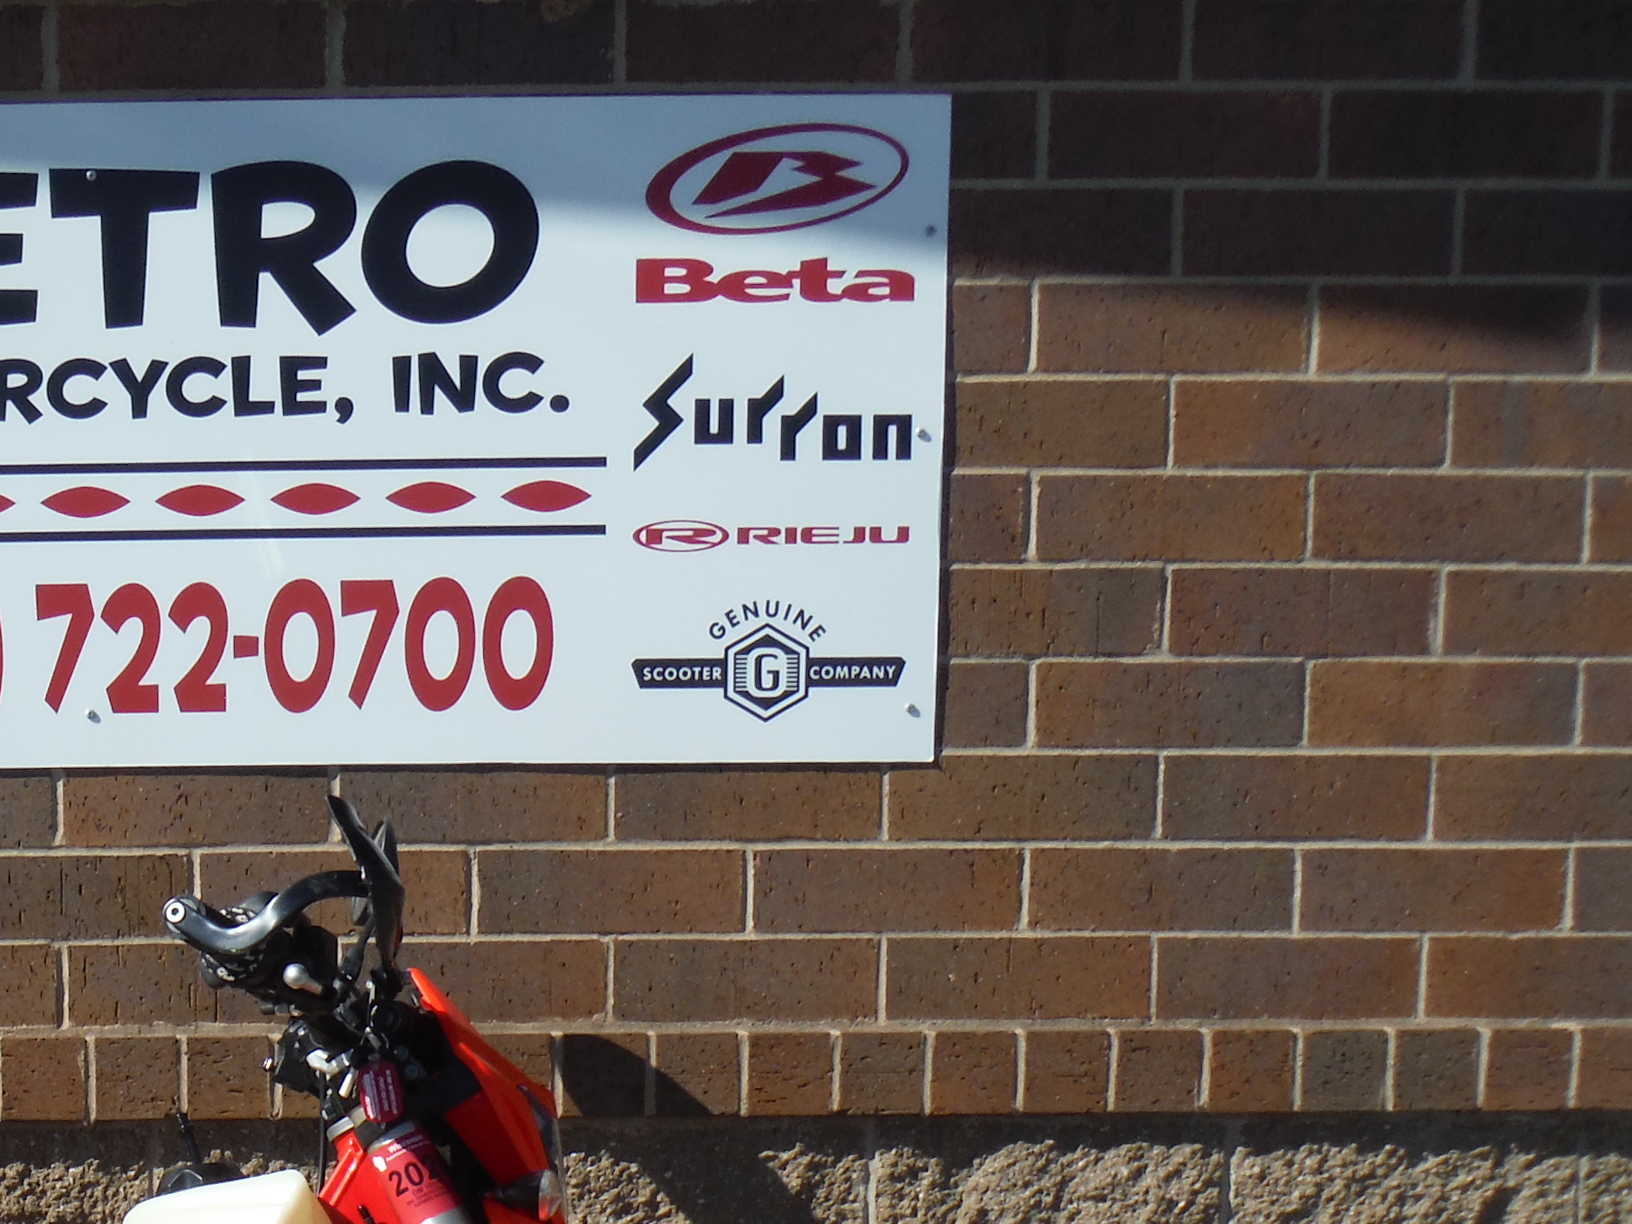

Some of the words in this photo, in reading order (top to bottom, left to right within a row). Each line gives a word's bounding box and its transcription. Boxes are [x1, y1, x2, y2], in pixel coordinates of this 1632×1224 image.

[636, 257, 916, 304] Beta
[391, 351, 571, 416] INC.
[634, 353, 913, 470] Surron
[736, 526, 911, 546] RIEJU
[708, 599, 827, 642] GENUINE
[35, 576, 554, 715] 722-0700
[641, 666, 723, 682] SCOOTER
[808, 664, 897, 681] COMPANY
